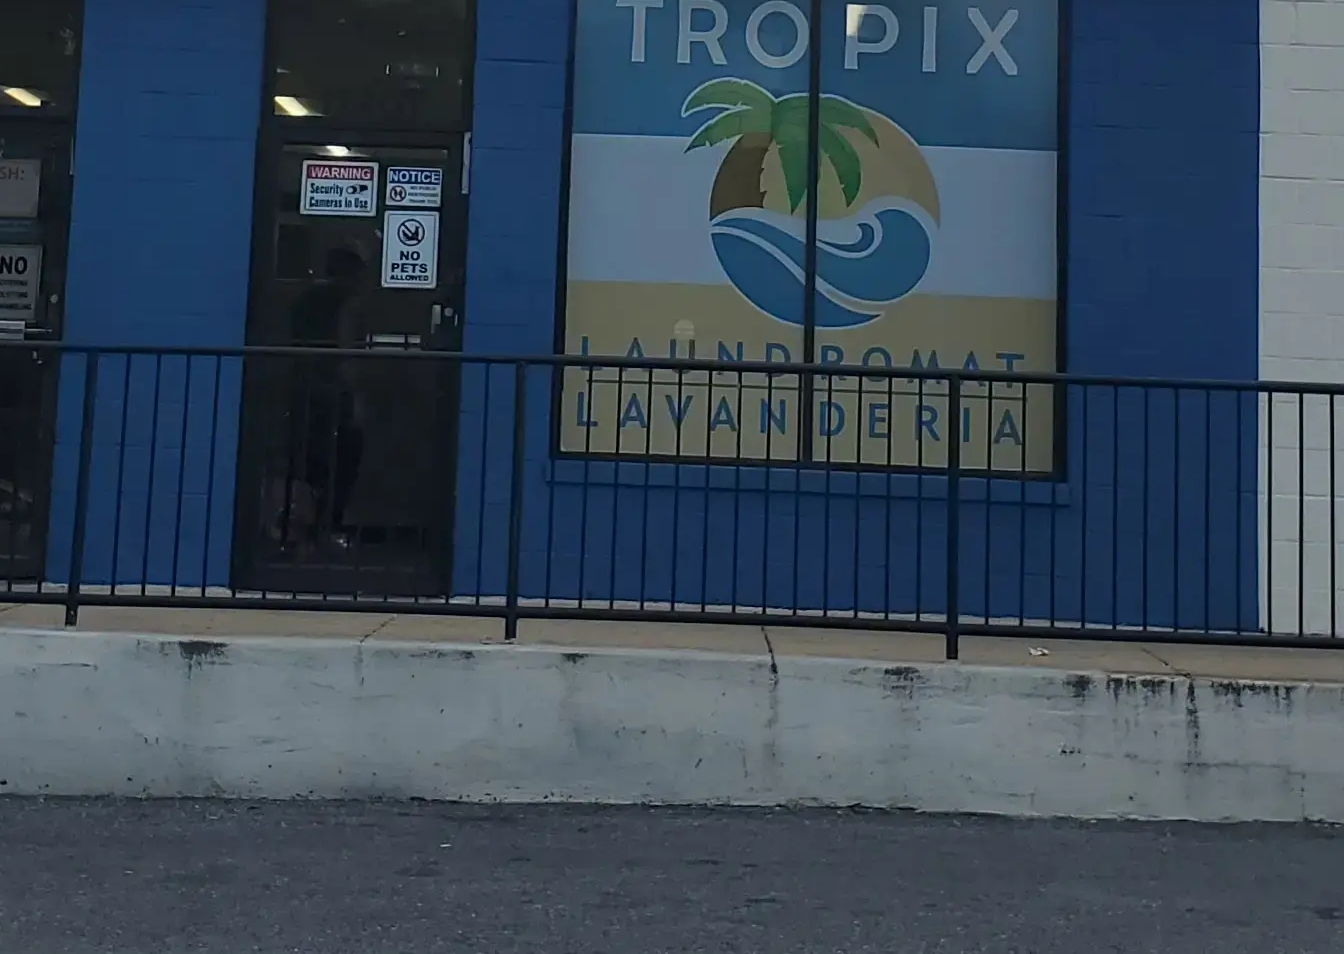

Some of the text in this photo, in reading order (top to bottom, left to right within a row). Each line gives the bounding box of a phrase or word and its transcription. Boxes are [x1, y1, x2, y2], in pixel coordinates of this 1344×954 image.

[311, 166, 371, 179] WARNING
[389, 170, 441, 183] NOTICE
[310, 182, 344, 197] Security
[309, 197, 342, 208] Cameras
[354, 198, 368, 209] Use
[399, 250, 421, 261] NO
[0, 255, 28, 275] NO
[391, 262, 428, 273] PETS
[578, 335, 1026, 390] LAUNDROMAT
[575, 391, 1023, 447] LAVANDERIA
